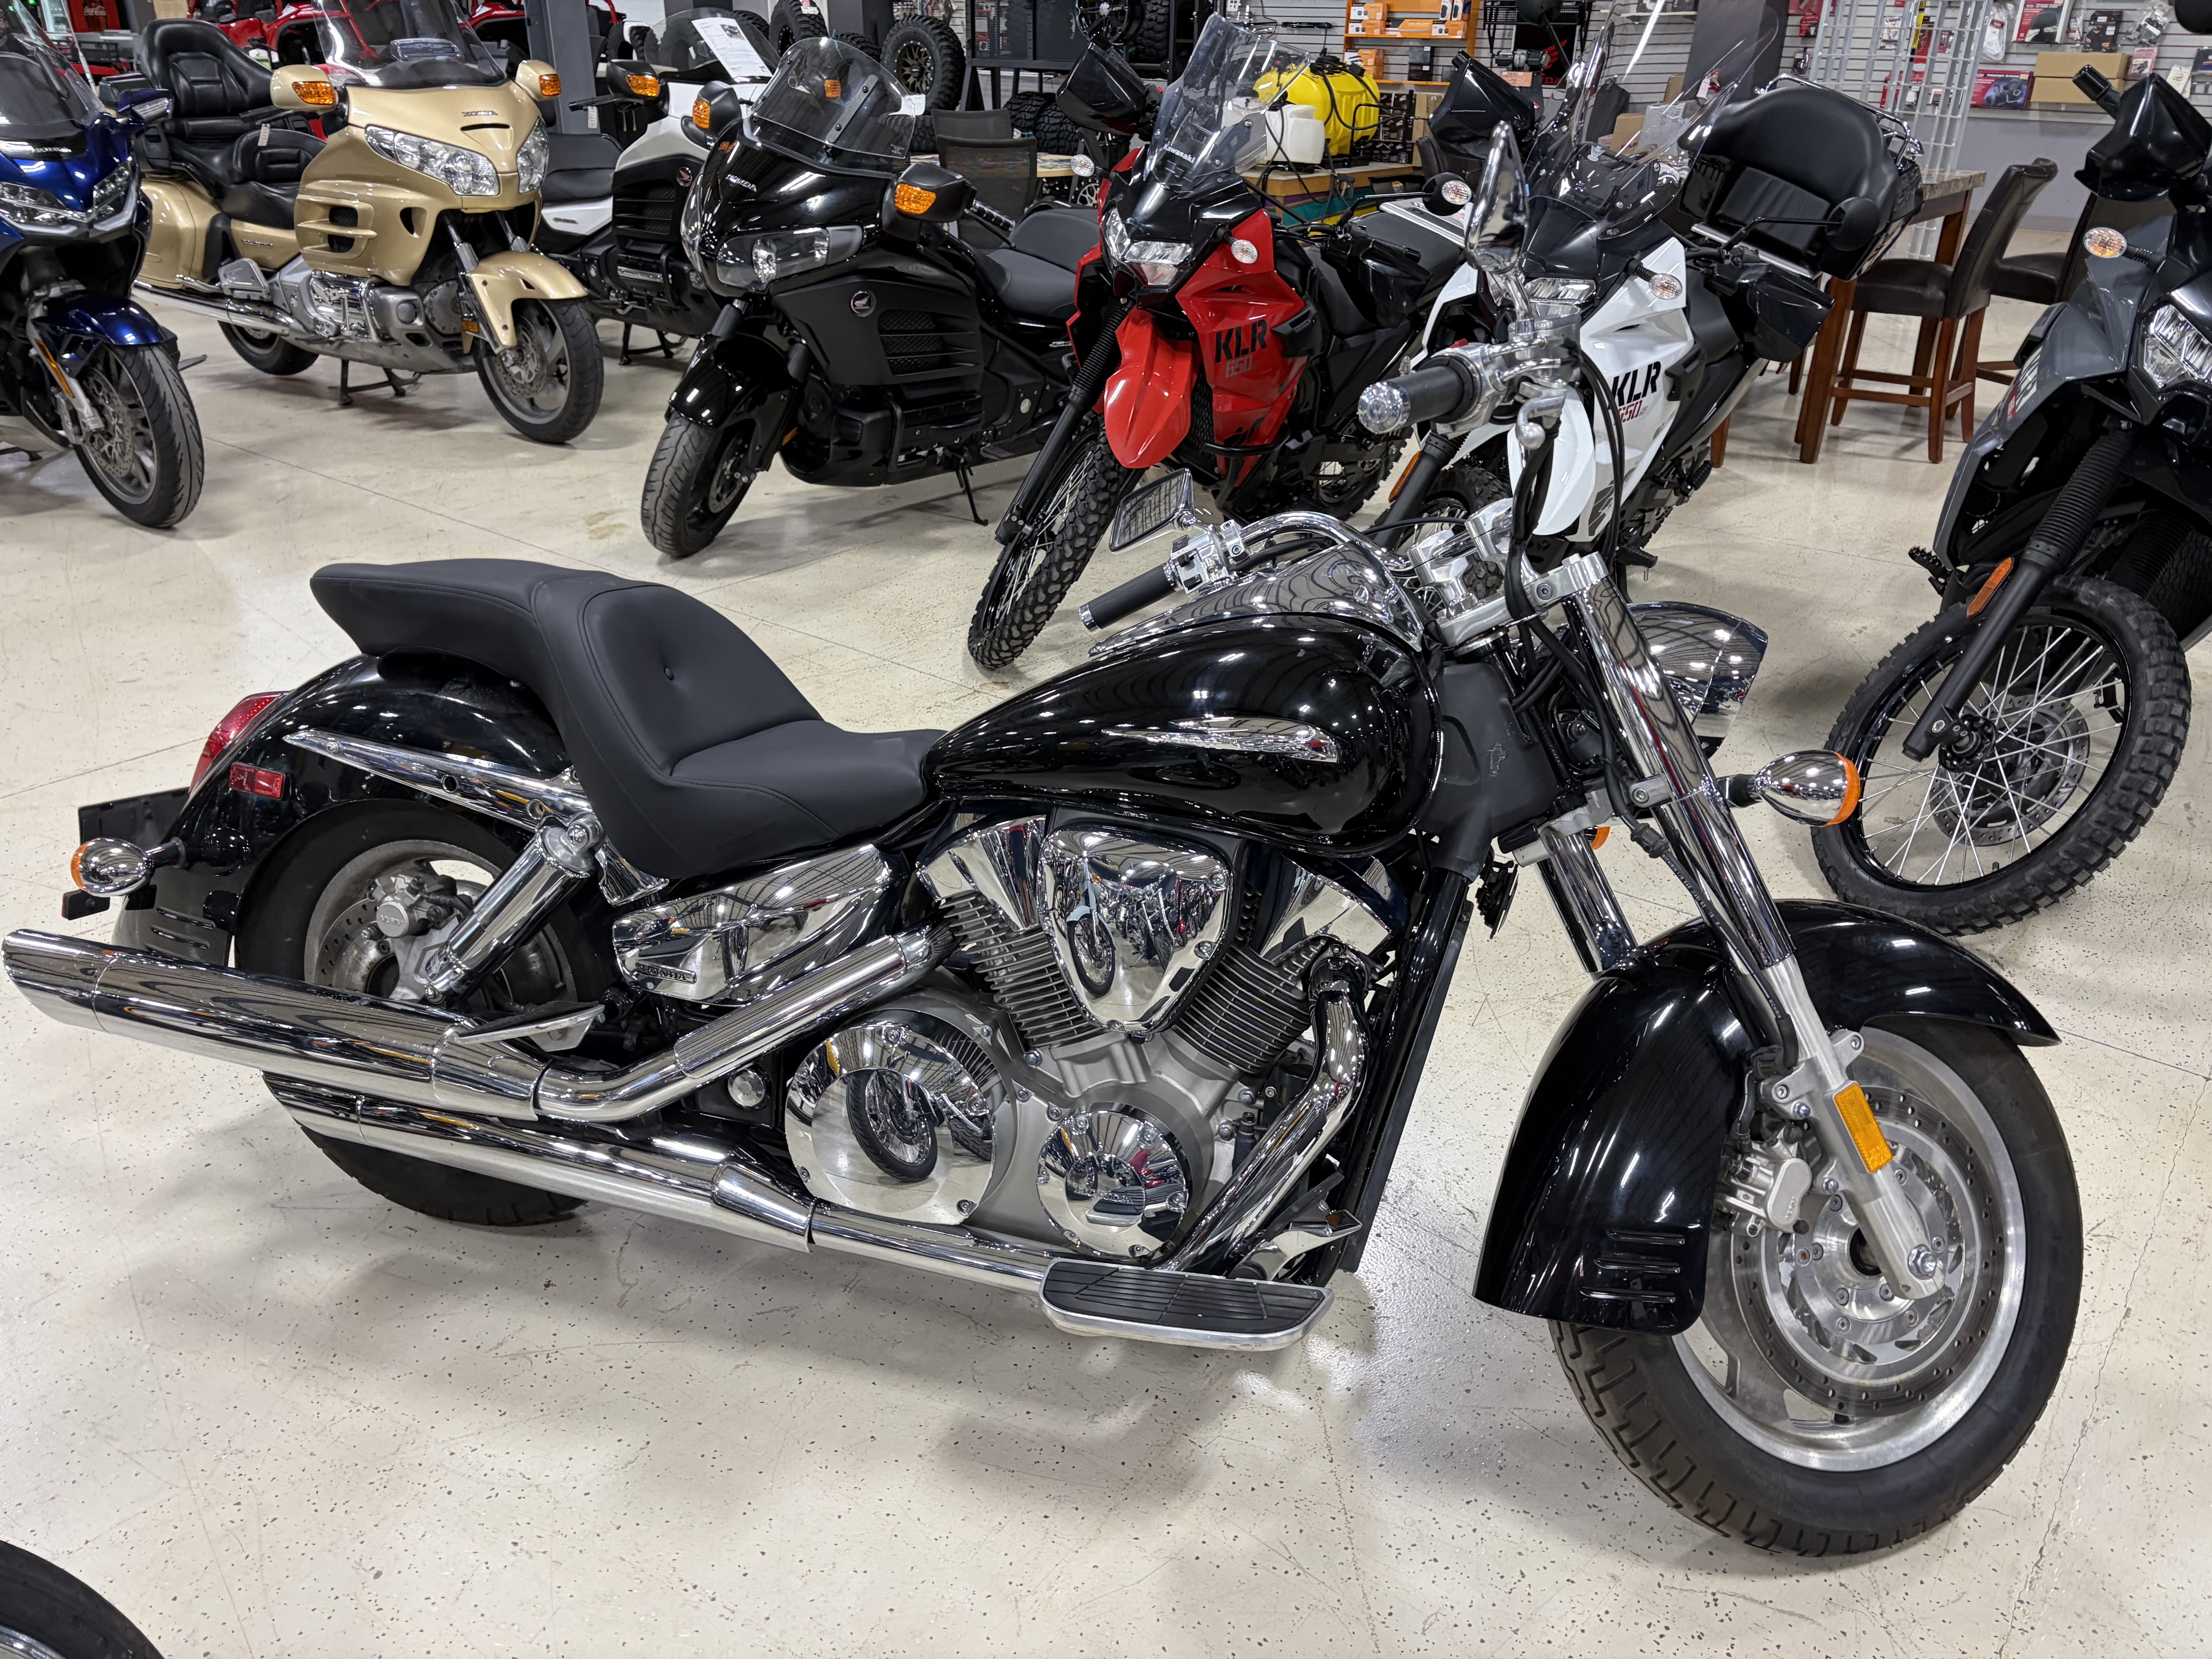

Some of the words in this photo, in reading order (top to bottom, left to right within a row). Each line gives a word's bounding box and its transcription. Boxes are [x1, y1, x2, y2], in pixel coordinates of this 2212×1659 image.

[1163, 141, 1195, 163] Kawasaki
[1215, 319, 1267, 363] KLR
[1225, 355, 1253, 378] 650
[1612, 361, 1661, 407] KLR
[1661, 854, 1678, 872] NICHIRIN
[1683, 880, 1692, 888] SAE
[643, 965, 687, 981] HONDA
[1769, 999, 1782, 1019] NICHIRIN
[1074, 1185, 1133, 1204] HONDA
